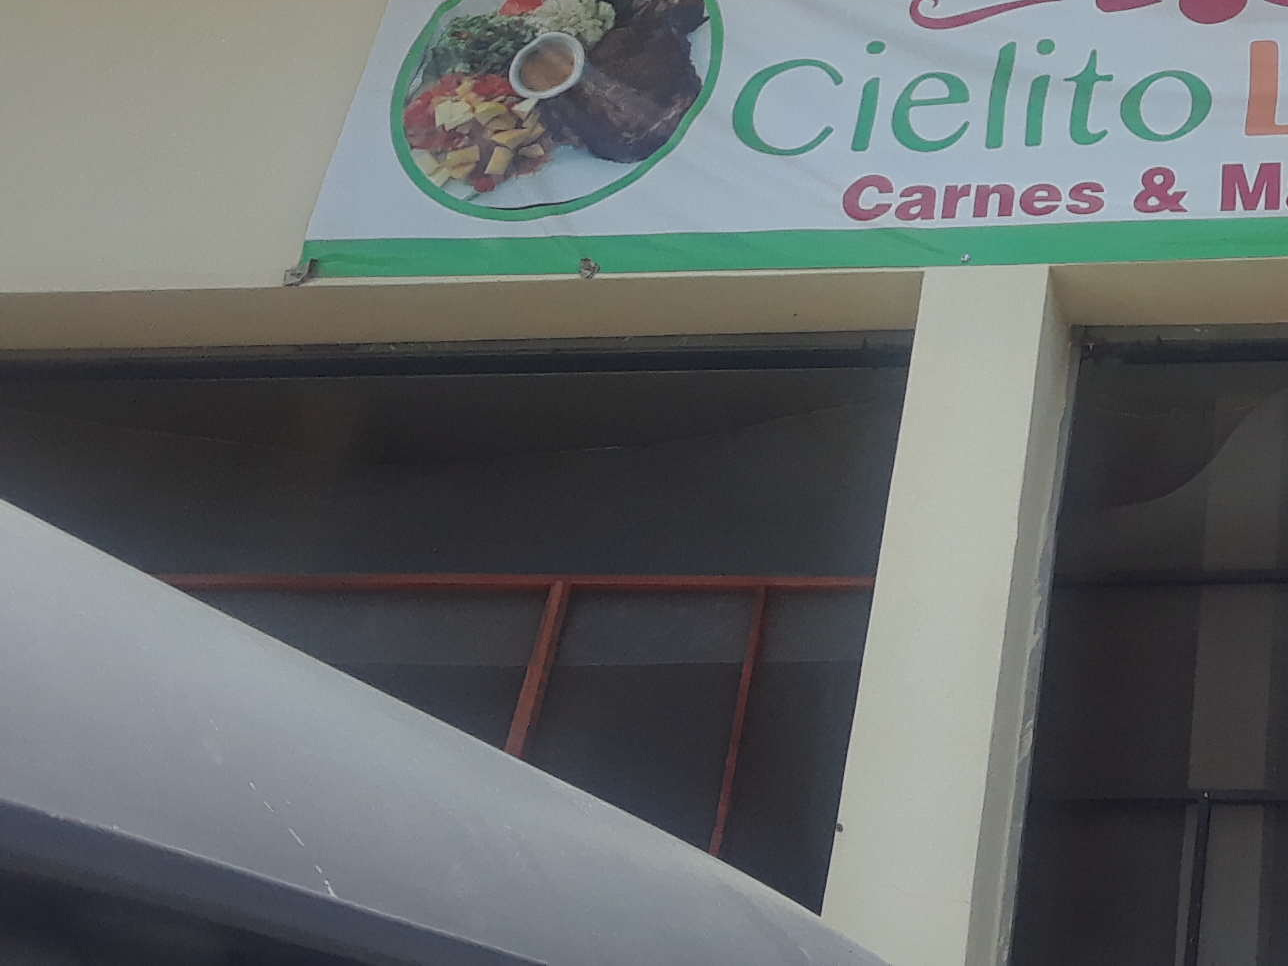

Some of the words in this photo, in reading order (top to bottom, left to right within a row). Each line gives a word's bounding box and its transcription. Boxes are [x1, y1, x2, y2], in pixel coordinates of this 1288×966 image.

[732, 38, 1212, 156] Cielito
[841, 173, 1105, 222] Carnes
[1132, 165, 1188, 214] &
